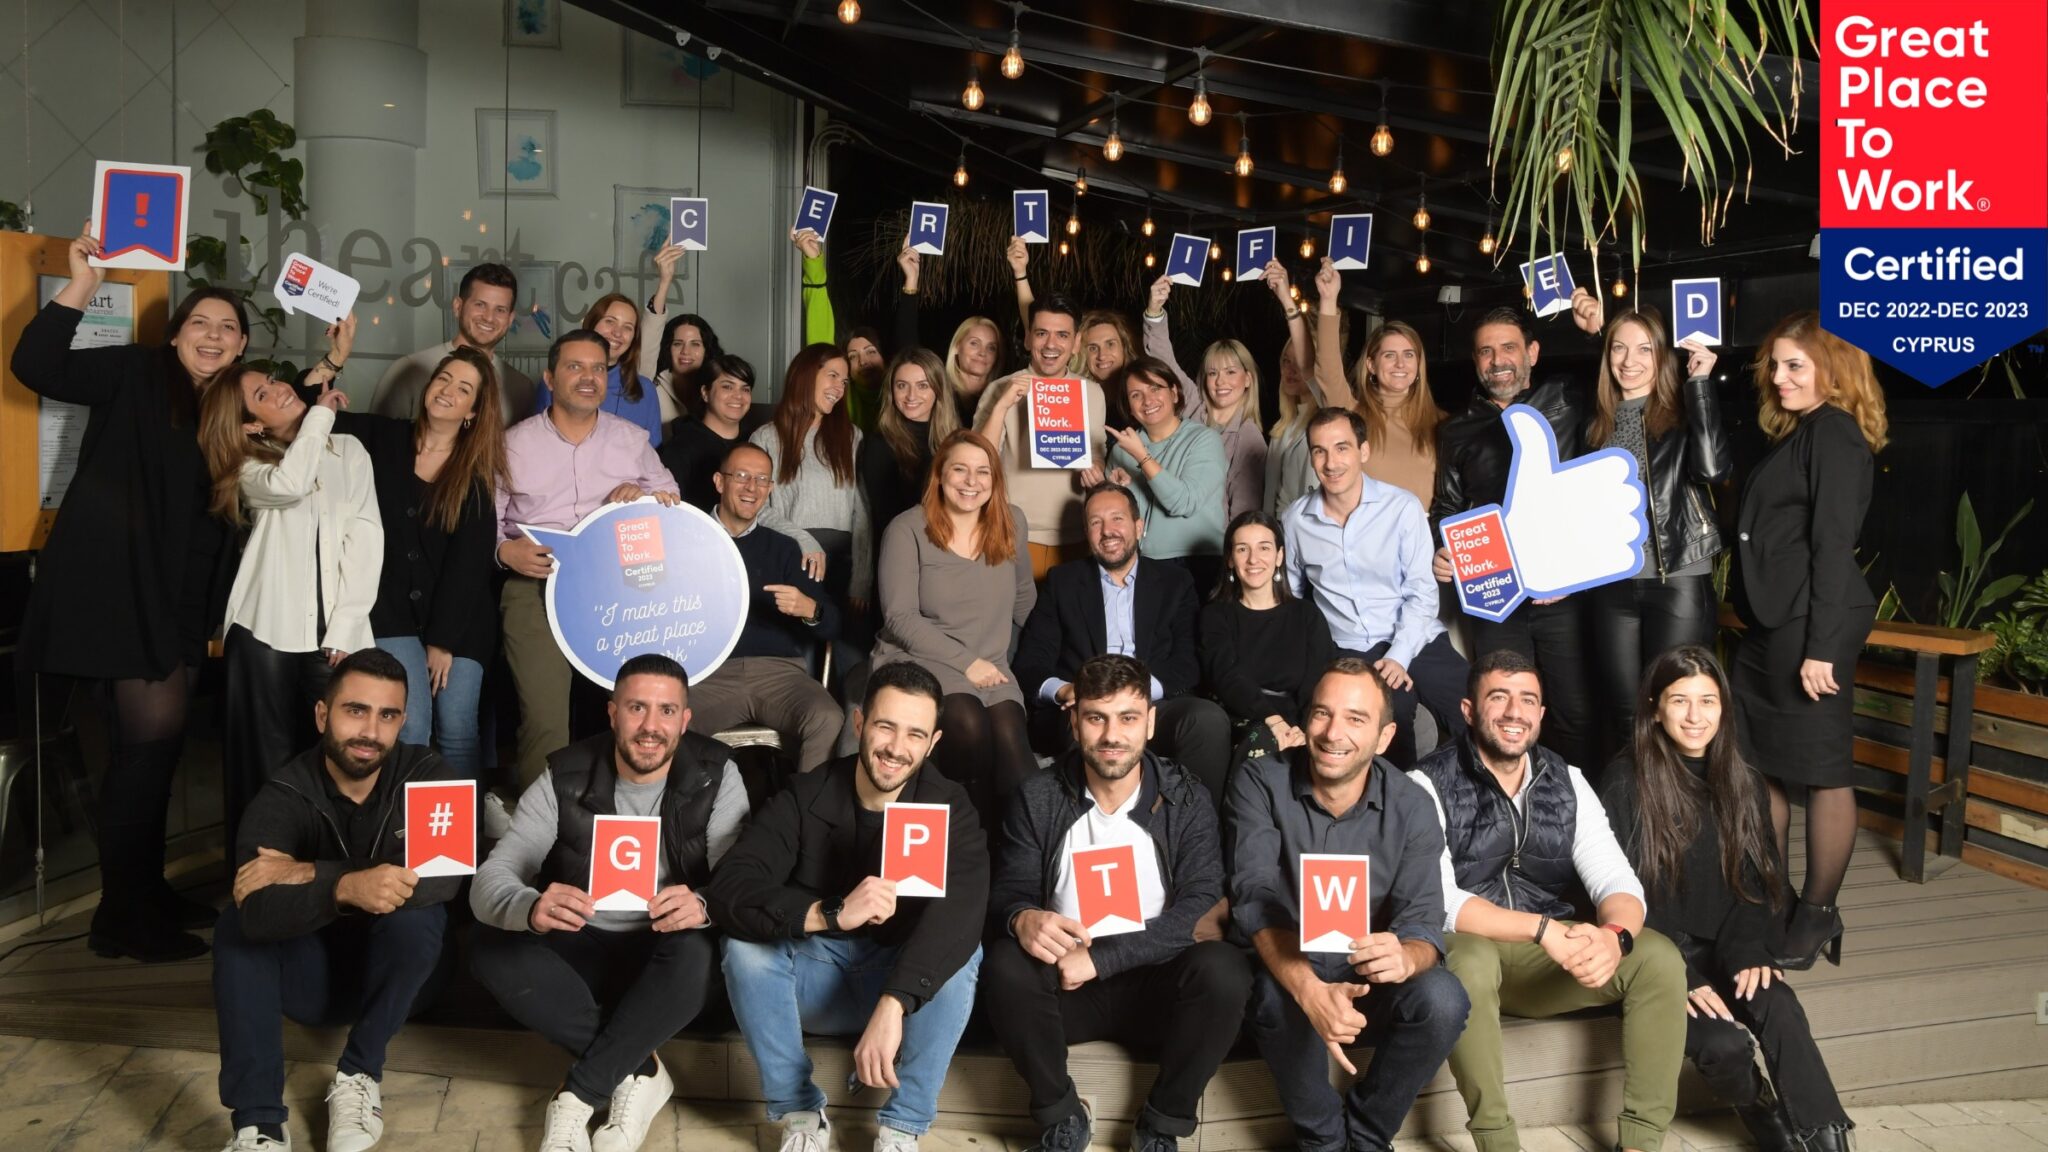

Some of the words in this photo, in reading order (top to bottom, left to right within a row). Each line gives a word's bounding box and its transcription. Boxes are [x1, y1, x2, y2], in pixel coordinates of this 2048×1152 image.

[680, 208, 698, 229] C
[808, 199, 825, 220] E
[920, 213, 937, 233] R
[1023, 201, 1038, 221] T
[1184, 246, 1193, 264] I
[1249, 238, 1264, 259] F
[1346, 225, 1354, 246] I
[1537, 267, 1560, 290] E
[1686, 293, 1709, 319] D
[318, 280, 338, 296] We're
[1035, 381, 1070, 393] Great
[1036, 393, 1071, 404] Place
[1036, 404, 1051, 415] To
[1040, 434, 1081, 444] Certified
[618, 521, 650, 533] Great
[1450, 522, 1488, 540] Great
[620, 532, 651, 543] Place
[1453, 535, 1490, 552] Place
[622, 543, 634, 552] To
[1456, 553, 1472, 564] To
[625, 562, 664, 577] Certified
[1465, 573, 1513, 594] Certified
[1482, 589, 1501, 599] 2023
[622, 600, 668, 622] make
[673, 594, 703, 614] this
[597, 637, 609, 652] a
[613, 625, 660, 656] great
[662, 620, 707, 646] place
[428, 802, 454, 837] #
[902, 823, 930, 857] P
[609, 834, 641, 871] G
[1090, 862, 1118, 897] T
[1312, 875, 1358, 912] W
